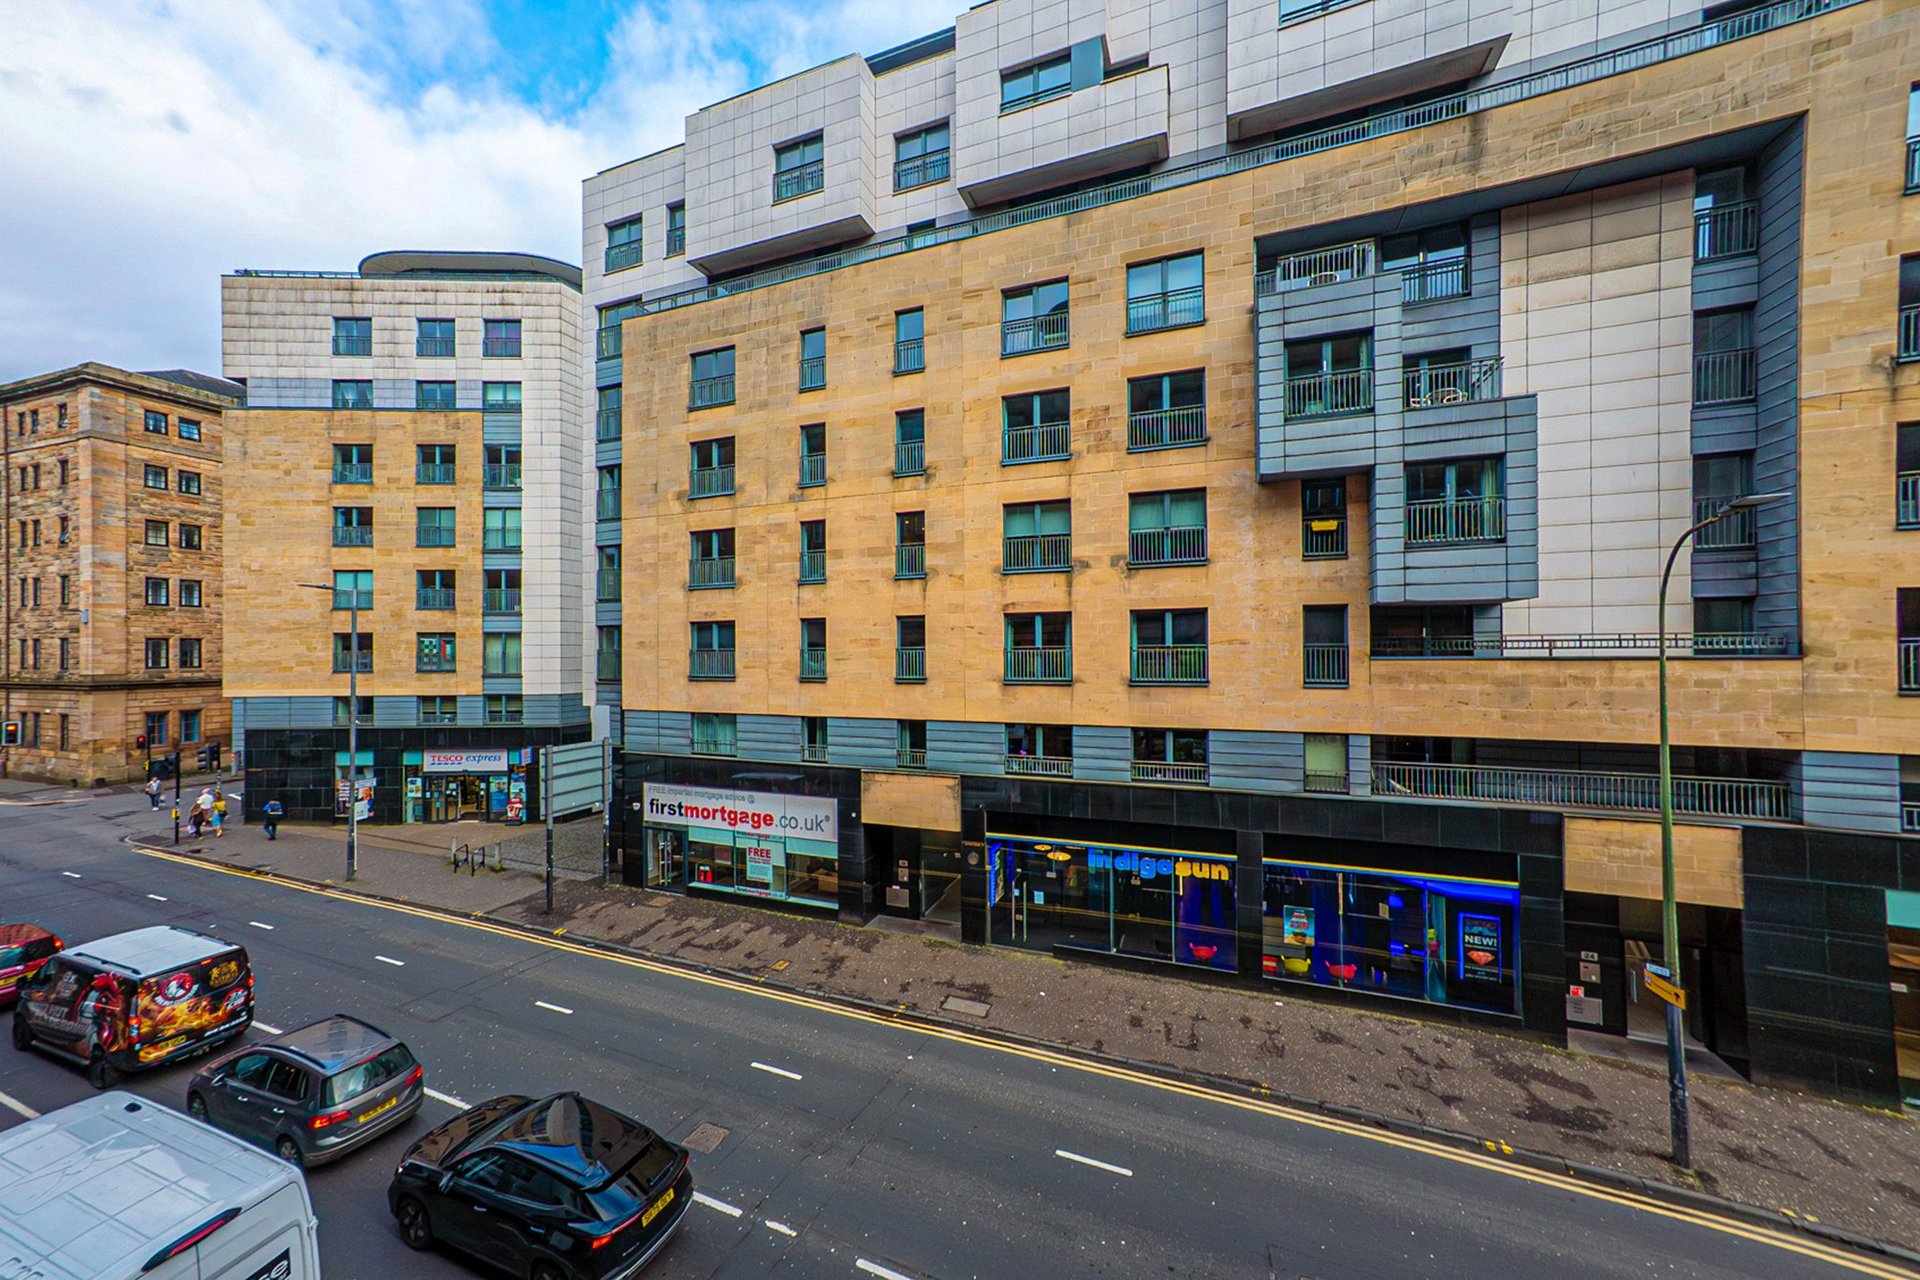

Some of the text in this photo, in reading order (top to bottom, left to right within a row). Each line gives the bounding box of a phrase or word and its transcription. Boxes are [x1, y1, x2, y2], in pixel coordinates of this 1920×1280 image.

[430, 754, 502, 764] TESCO express
[648, 785, 666, 795] FREE
[747, 847, 771, 858] FREE
[1464, 934, 1498, 946] NEW!
